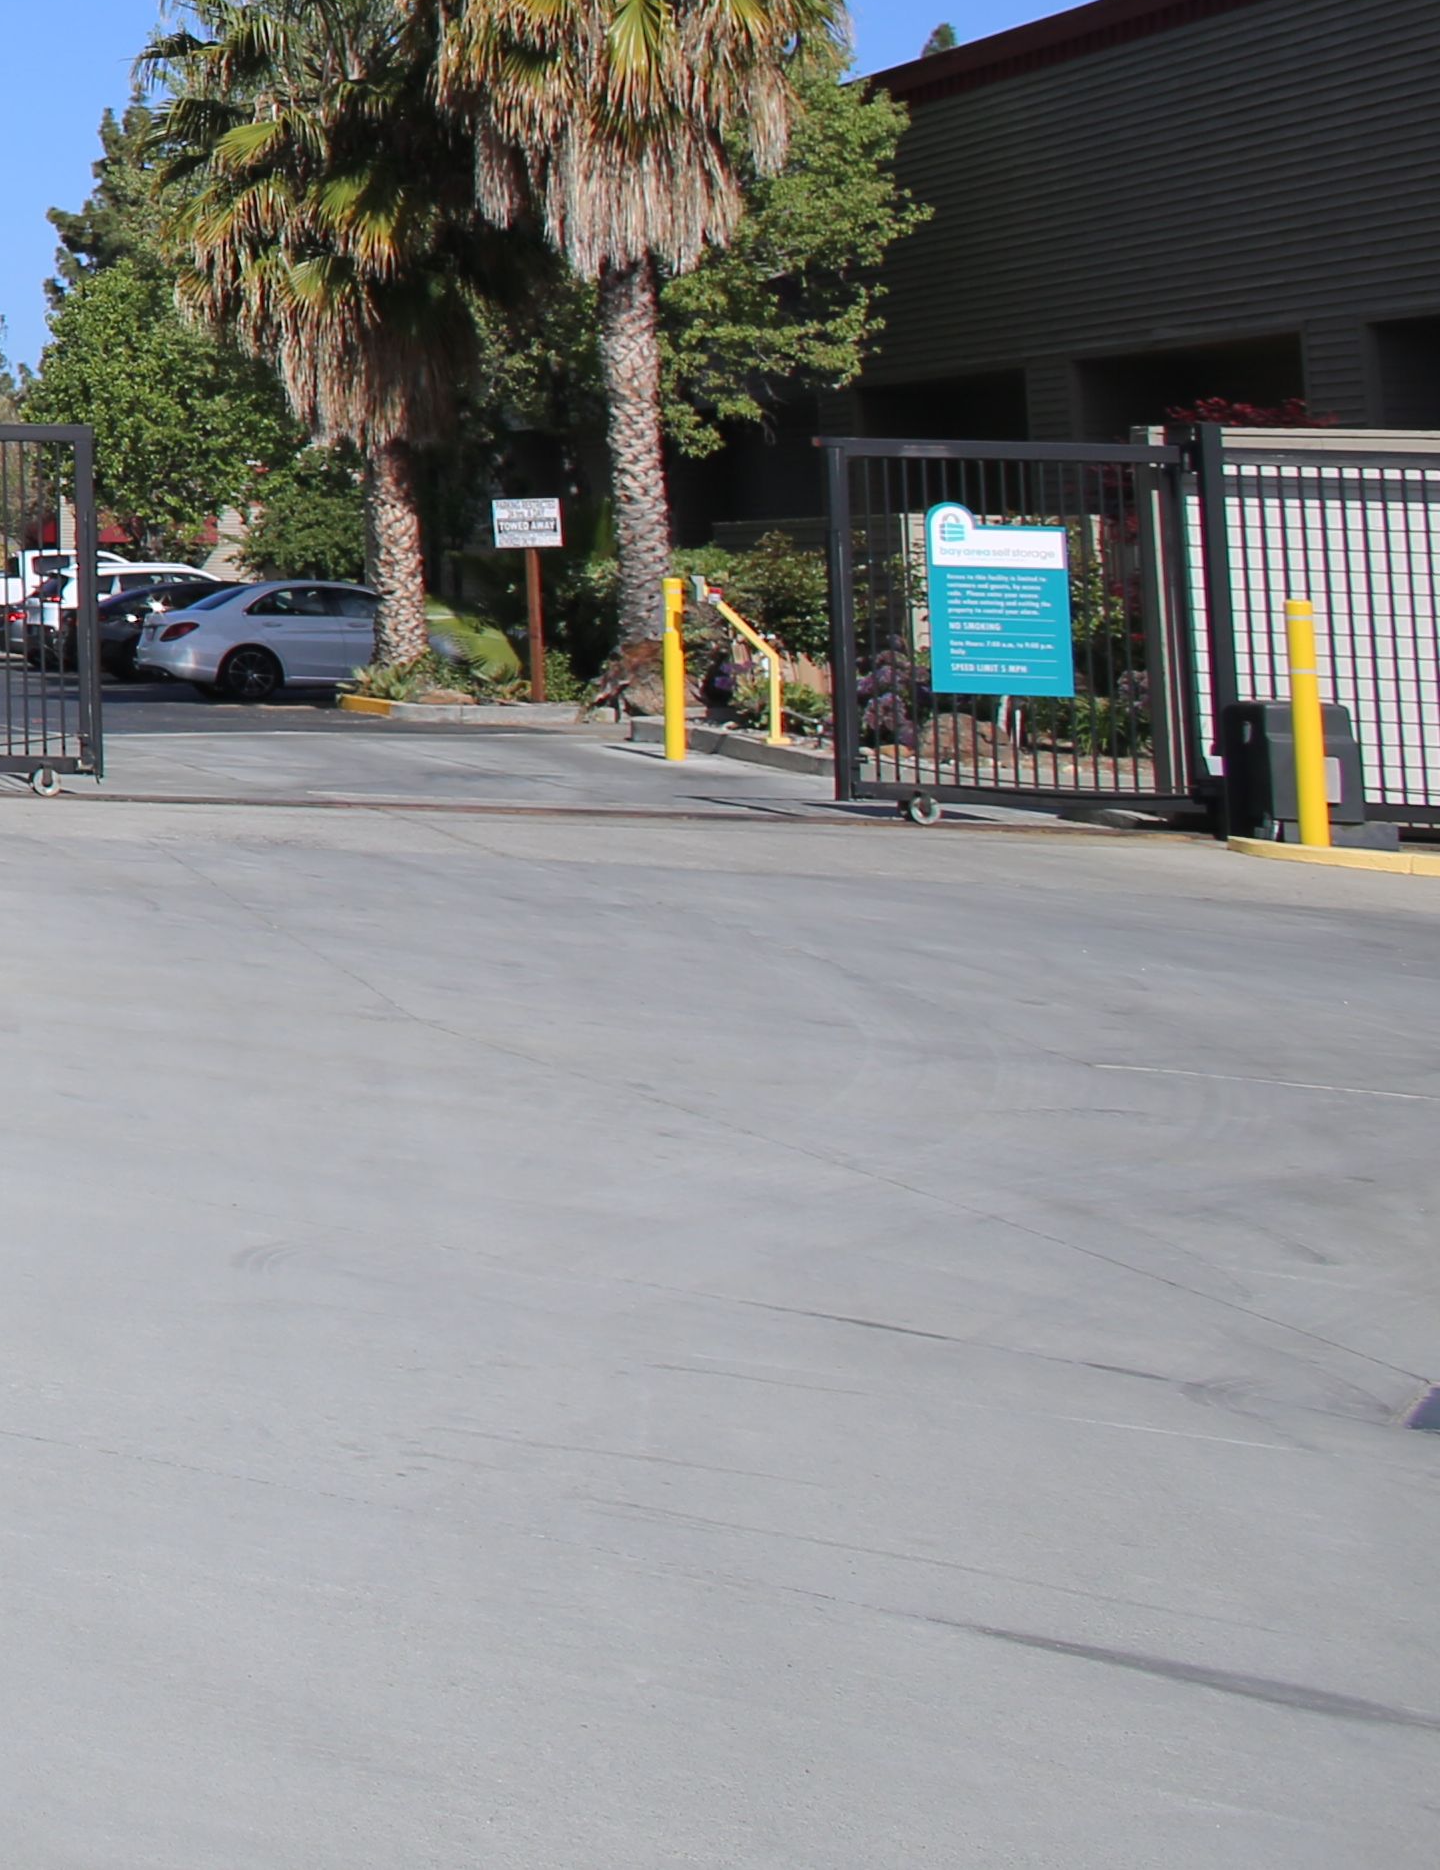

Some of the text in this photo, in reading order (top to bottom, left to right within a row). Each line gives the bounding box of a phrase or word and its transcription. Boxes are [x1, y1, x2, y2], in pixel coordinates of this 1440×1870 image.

[499, 521, 555, 531] TOWED AWAY
[940, 546, 1055, 560] bay area self storage
[963, 622, 1002, 631] SMOKING
[951, 662, 1028, 673] SPEED LIMIT 5 MPH
